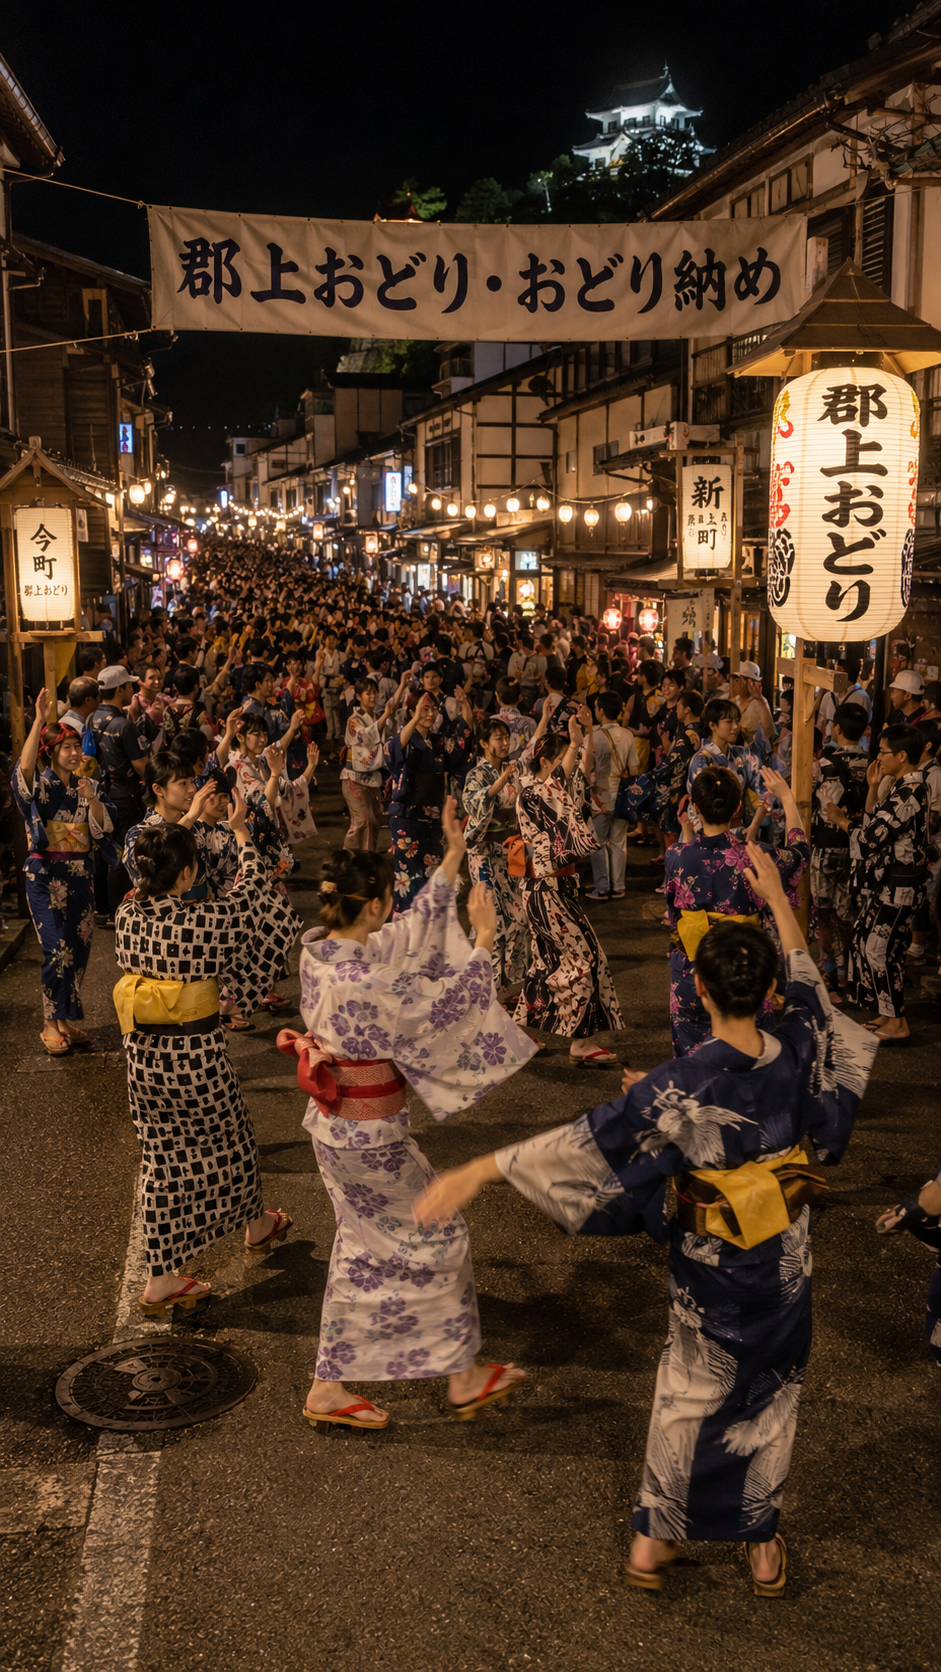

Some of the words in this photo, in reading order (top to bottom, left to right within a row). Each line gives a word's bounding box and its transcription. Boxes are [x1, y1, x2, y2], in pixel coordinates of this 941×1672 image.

[176, 237, 782, 314] 郡上おどり・おどり納め
[691, 475, 725, 551] 新町
[817, 383, 888, 622] 郡上おどり
[30, 523, 58, 580] 今町
